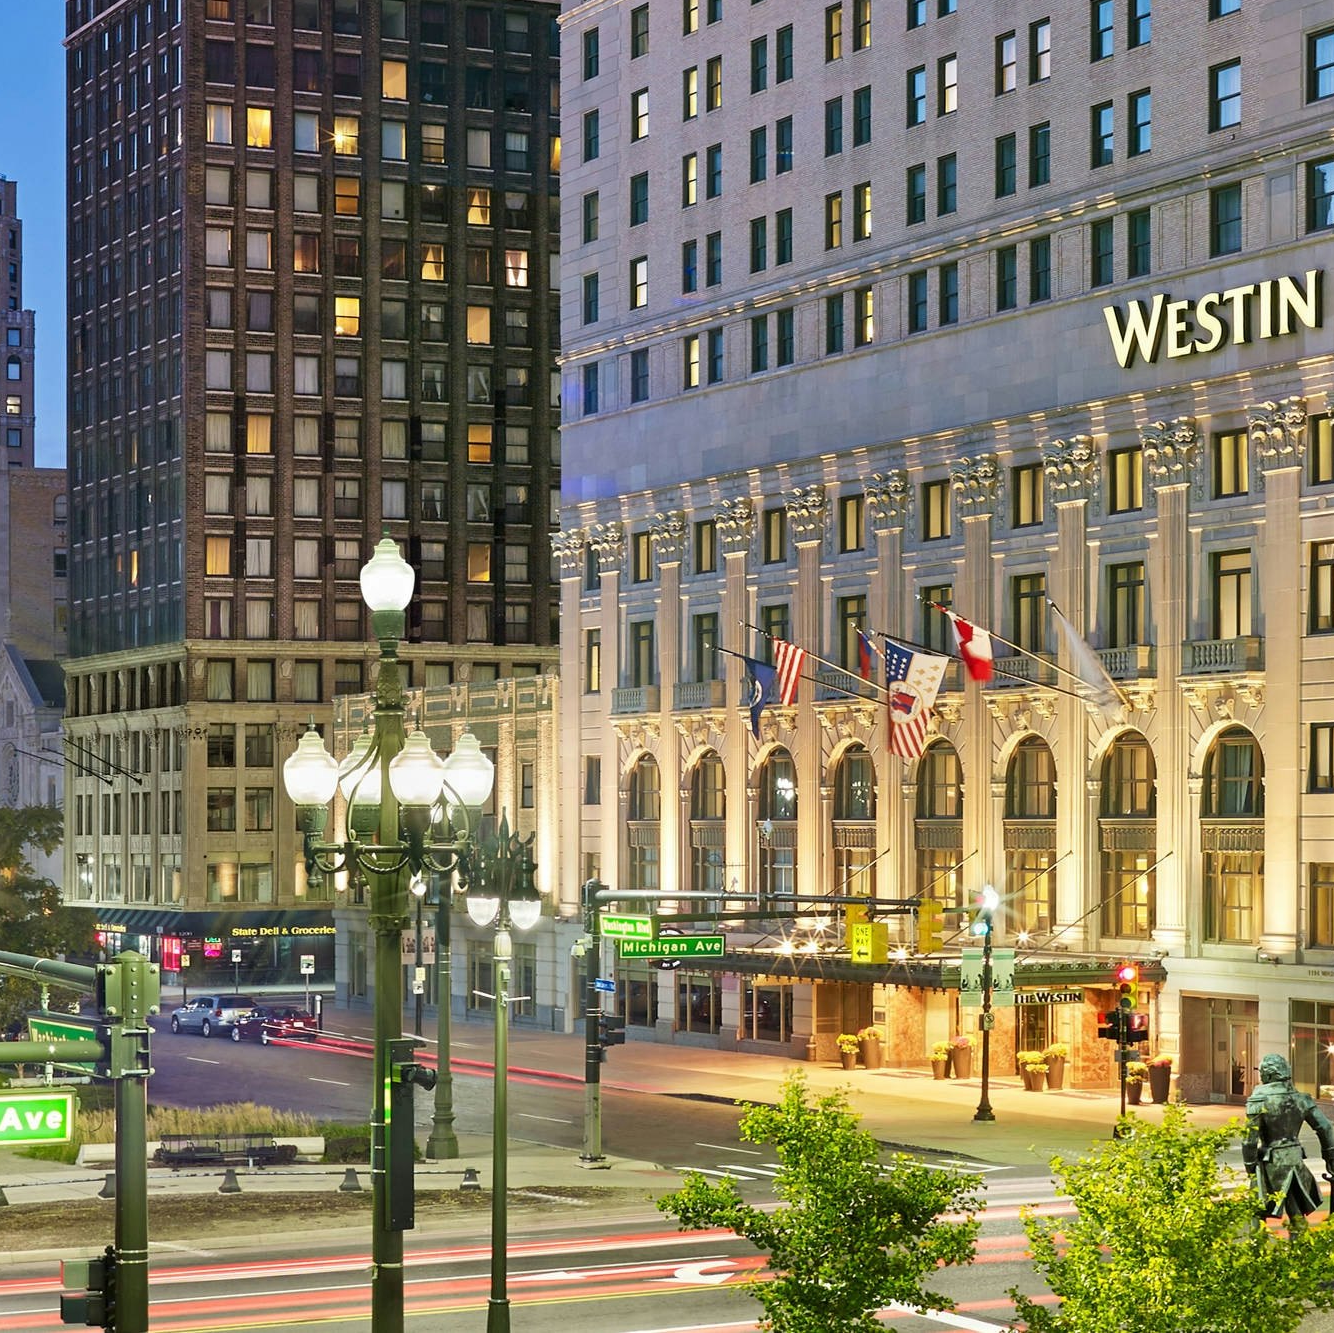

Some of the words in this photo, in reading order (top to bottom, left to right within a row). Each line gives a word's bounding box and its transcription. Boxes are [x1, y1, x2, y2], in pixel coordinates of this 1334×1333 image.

[1103, 269, 1324, 368] WESTIN
[232, 927, 258, 937] State
[259, 927, 279, 936] Deli
[281, 927, 289, 935] &
[291, 926, 337, 936] Groceries
[856, 927, 868, 936] ONE
[623, 941, 687, 954] Michigan
[695, 940, 721, 951] Ave
[856, 938, 868, 946] WAY
[1014, 993, 1036, 1004] THE
[1036, 992, 1082, 1003] WESTIN
